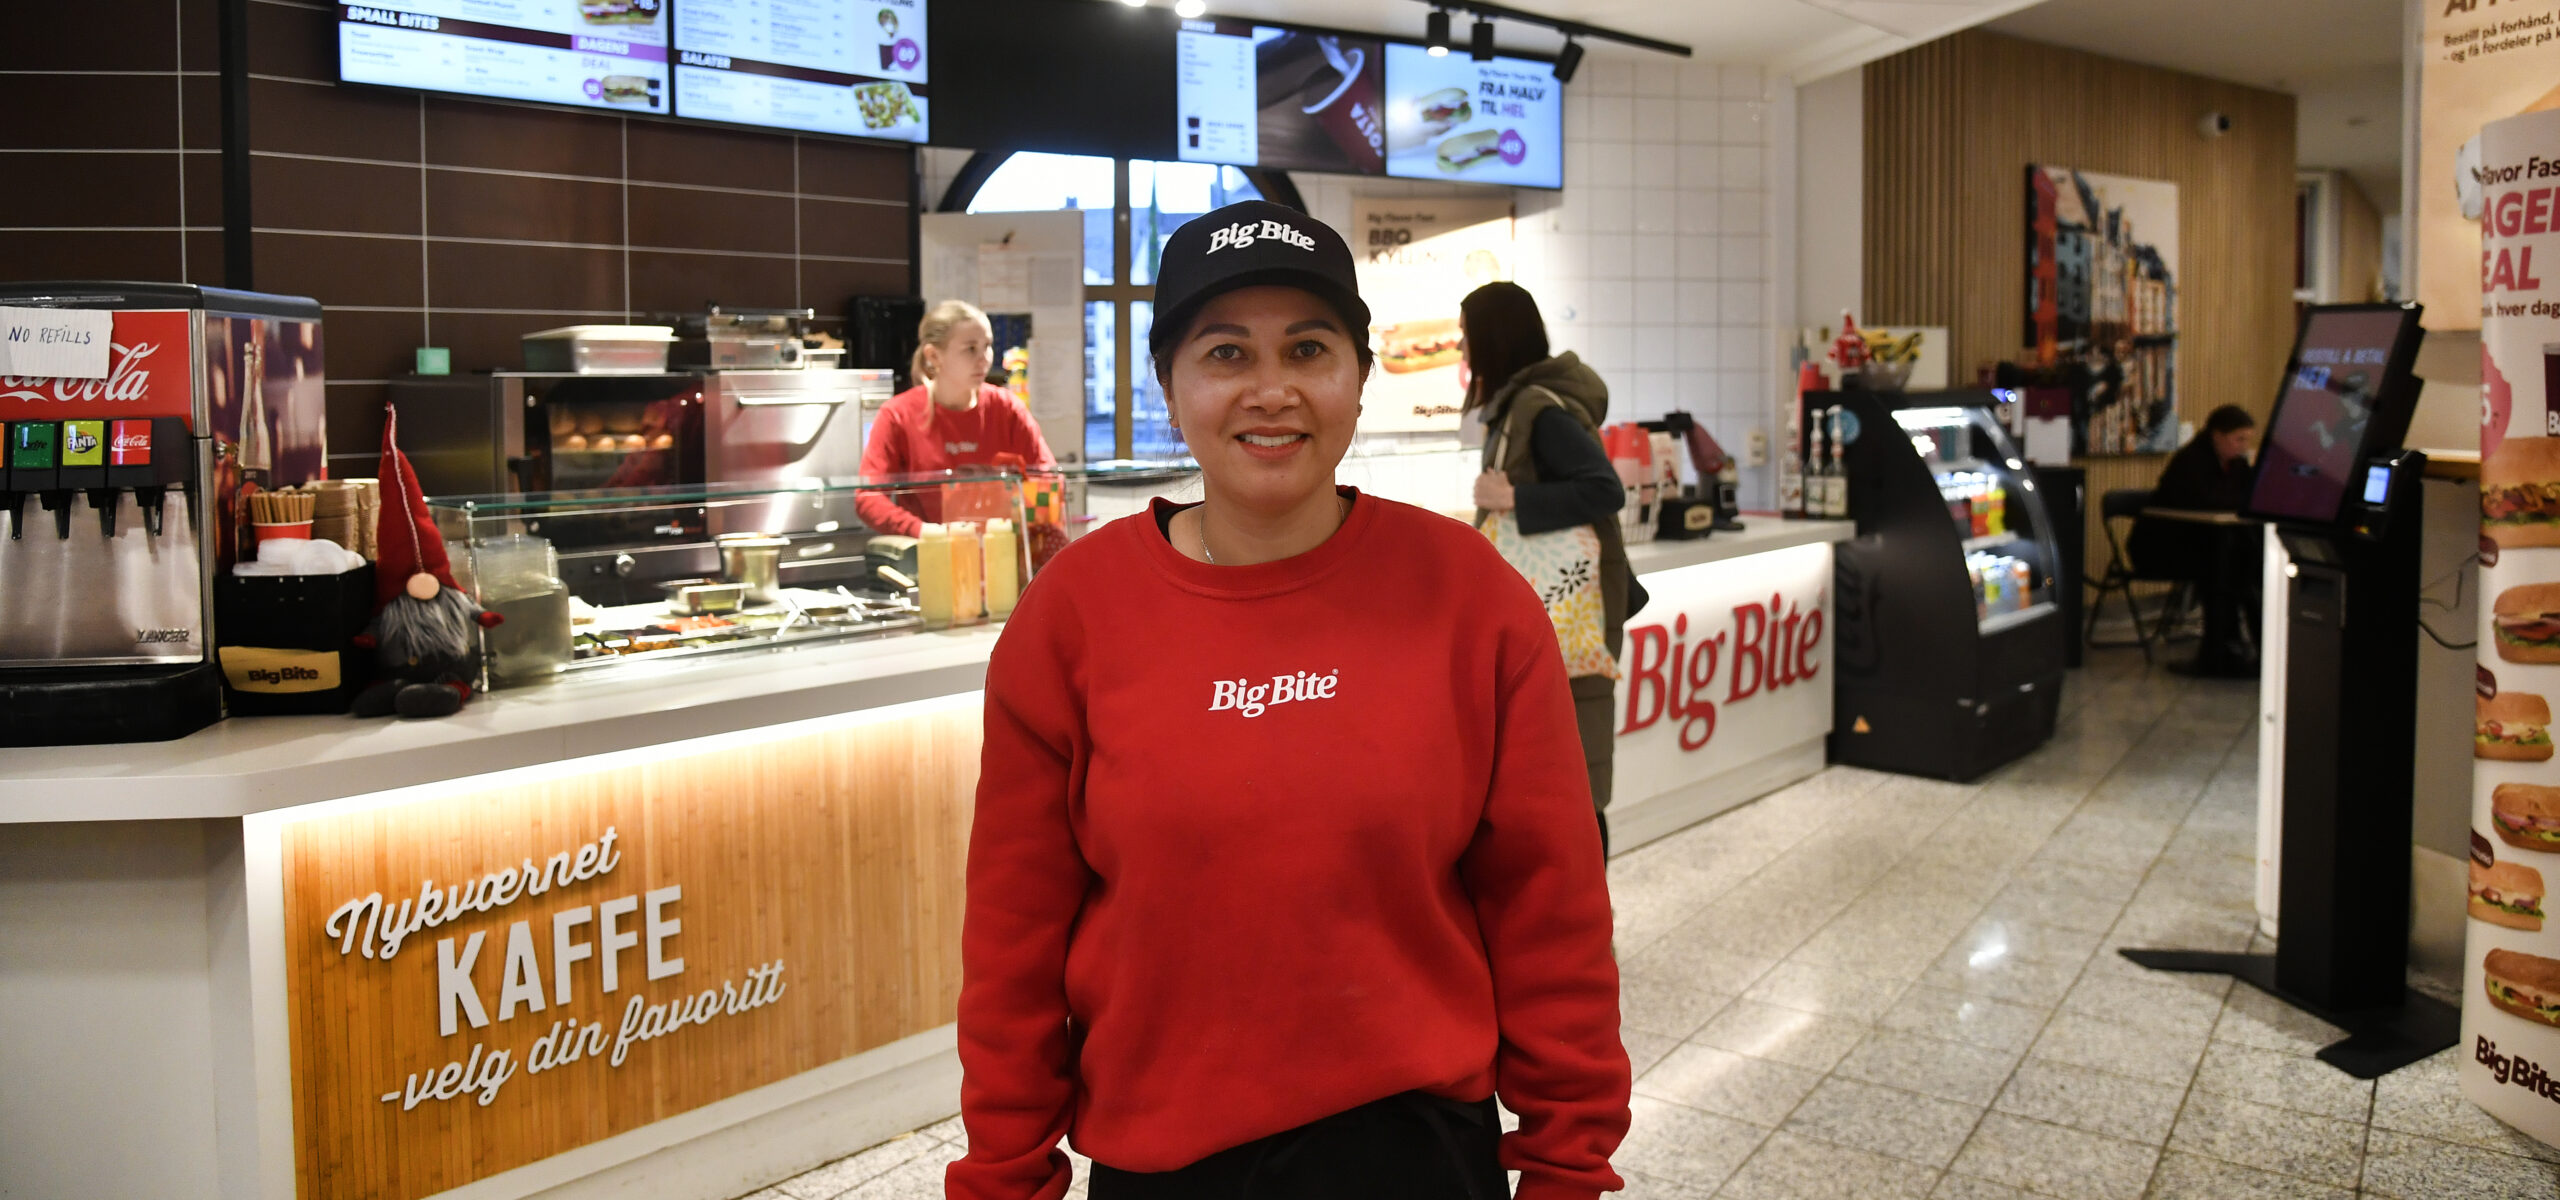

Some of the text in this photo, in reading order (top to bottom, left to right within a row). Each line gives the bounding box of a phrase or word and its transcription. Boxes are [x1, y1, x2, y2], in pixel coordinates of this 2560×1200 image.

[347, 6, 440, 31] SMALL BITES
[2482, 22, 2498, 41] på
[2482, 35, 2532, 54] fordeler
[2536, 27, 2552, 47] på
[578, 37, 630, 55] DAGENS
[681, 51, 731, 69] SALATER
[1479, 81, 1505, 97] FRA
[1481, 100, 1498, 115] TIL
[2527, 156, 2560, 179] Fas
[2482, 186, 2560, 240] AGE
[1206, 220, 1316, 255] Big Bite
[1369, 228, 1412, 246] BBQ
[2482, 246, 2541, 293] EAL
[2497, 302, 2527, 318] hver
[8, 325, 91, 344] NO REFILLS
[248, 666, 319, 684] Big Bite
[1617, 592, 1825, 752] Big Bite
[1208, 678, 1270, 718] Big
[325, 826, 621, 960] Nykværnet
[437, 884, 685, 1037] KAFFE
[527, 1018, 608, 1074] din
[610, 959, 786, 1067] favoritt
[2475, 1034, 2560, 1105] Big Bite
